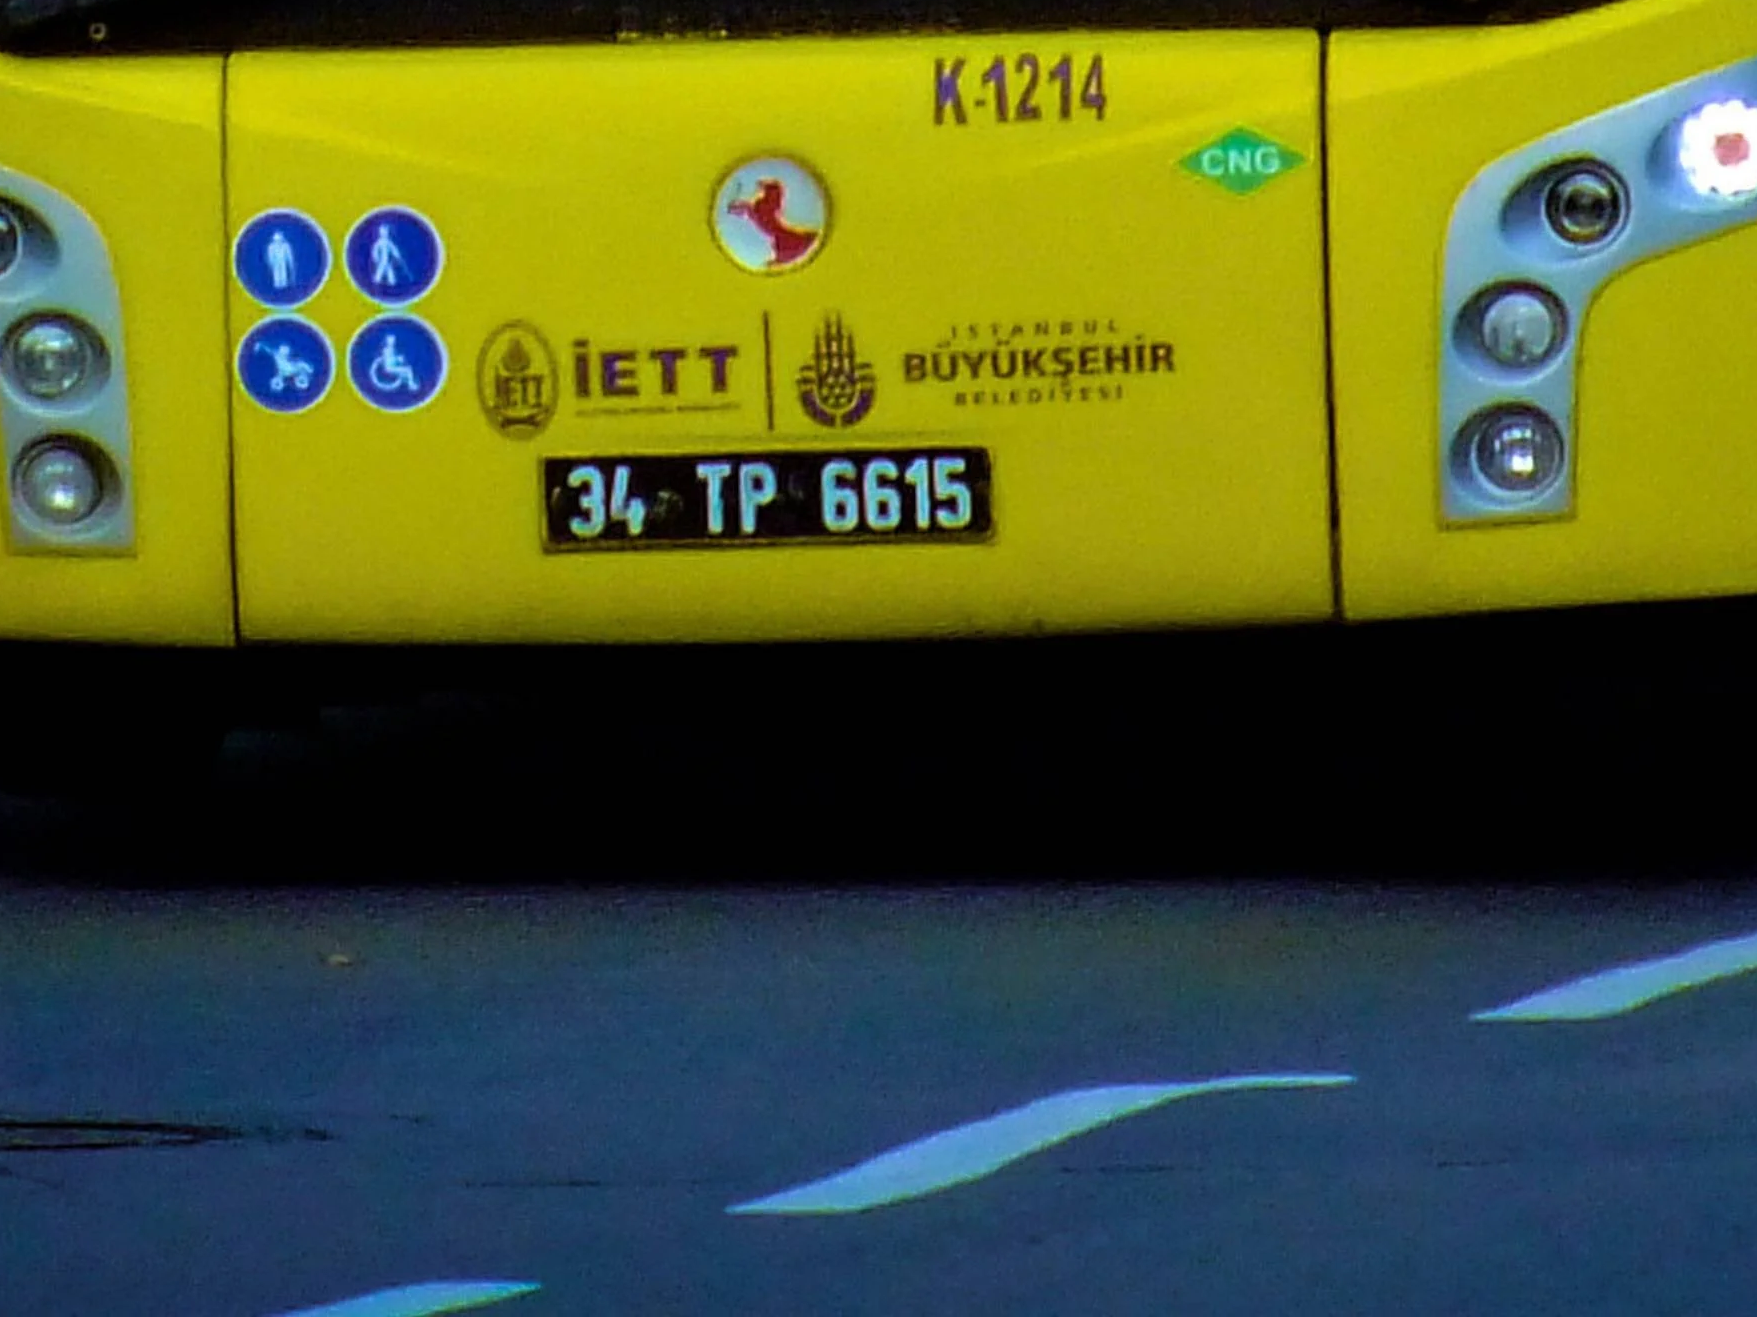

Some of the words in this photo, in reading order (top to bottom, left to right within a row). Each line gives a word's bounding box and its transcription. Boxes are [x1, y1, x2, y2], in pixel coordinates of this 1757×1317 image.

[934, 53, 1107, 125] K-1214
[1200, 145, 1281, 177] CNG
[573, 339, 737, 398] İETT
[904, 334, 1175, 387] BÜYÜKŞEHİR
[568, 466, 646, 537] 34
[697, 462, 777, 534] TP
[821, 457, 971, 532] 6615
